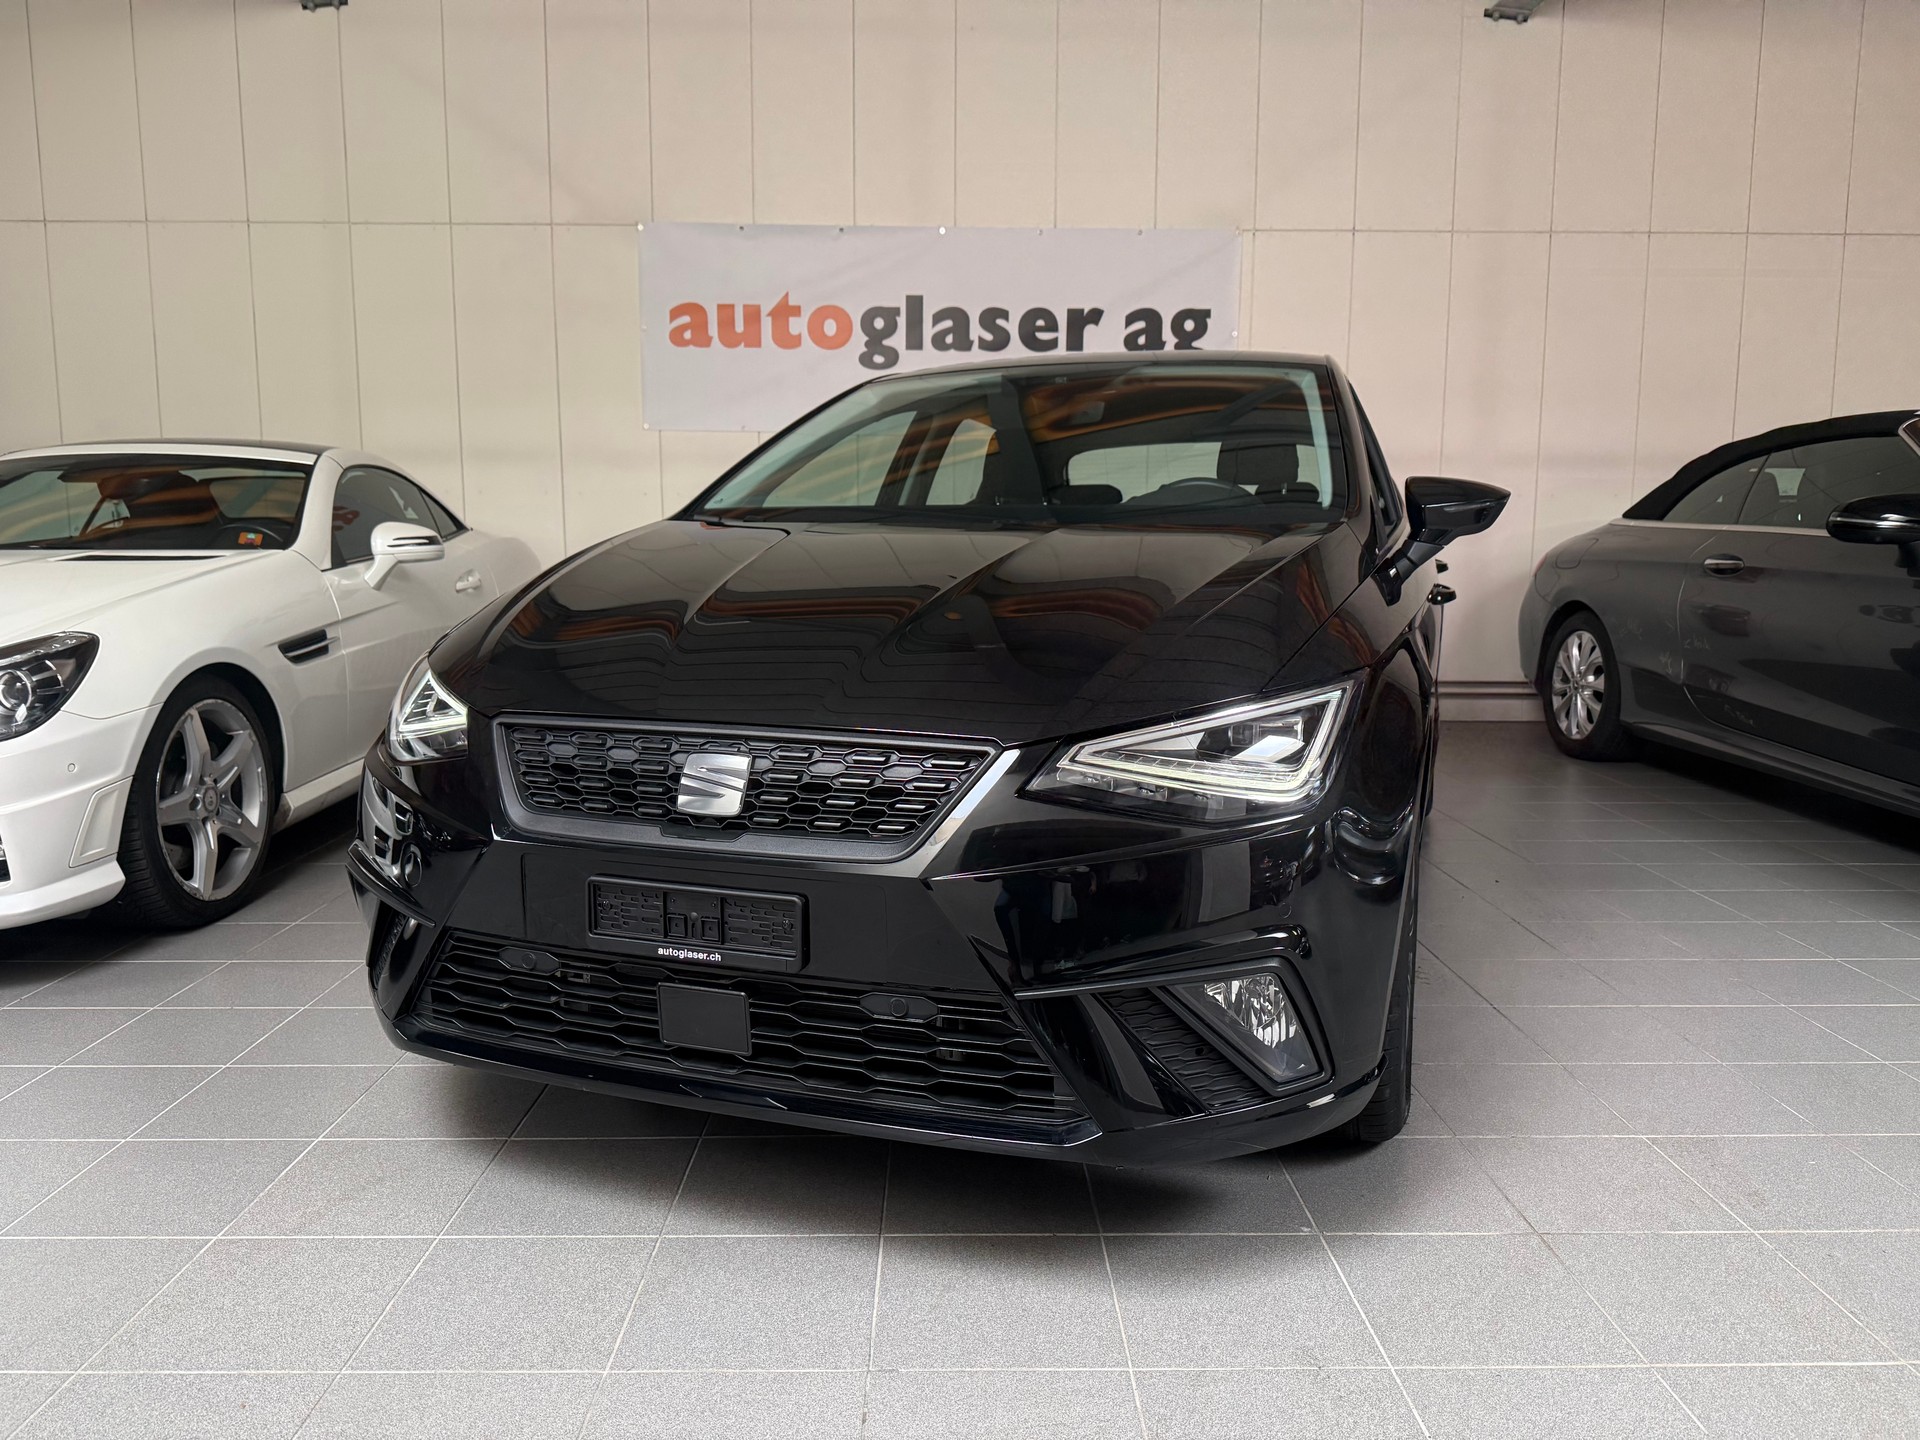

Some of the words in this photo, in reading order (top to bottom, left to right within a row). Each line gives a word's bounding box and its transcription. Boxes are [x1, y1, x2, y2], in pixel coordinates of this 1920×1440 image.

[668, 291, 1105, 370] autoglaser
[1123, 307, 1212, 351] ag
[657, 947, 722, 961] autoglaser.ch
